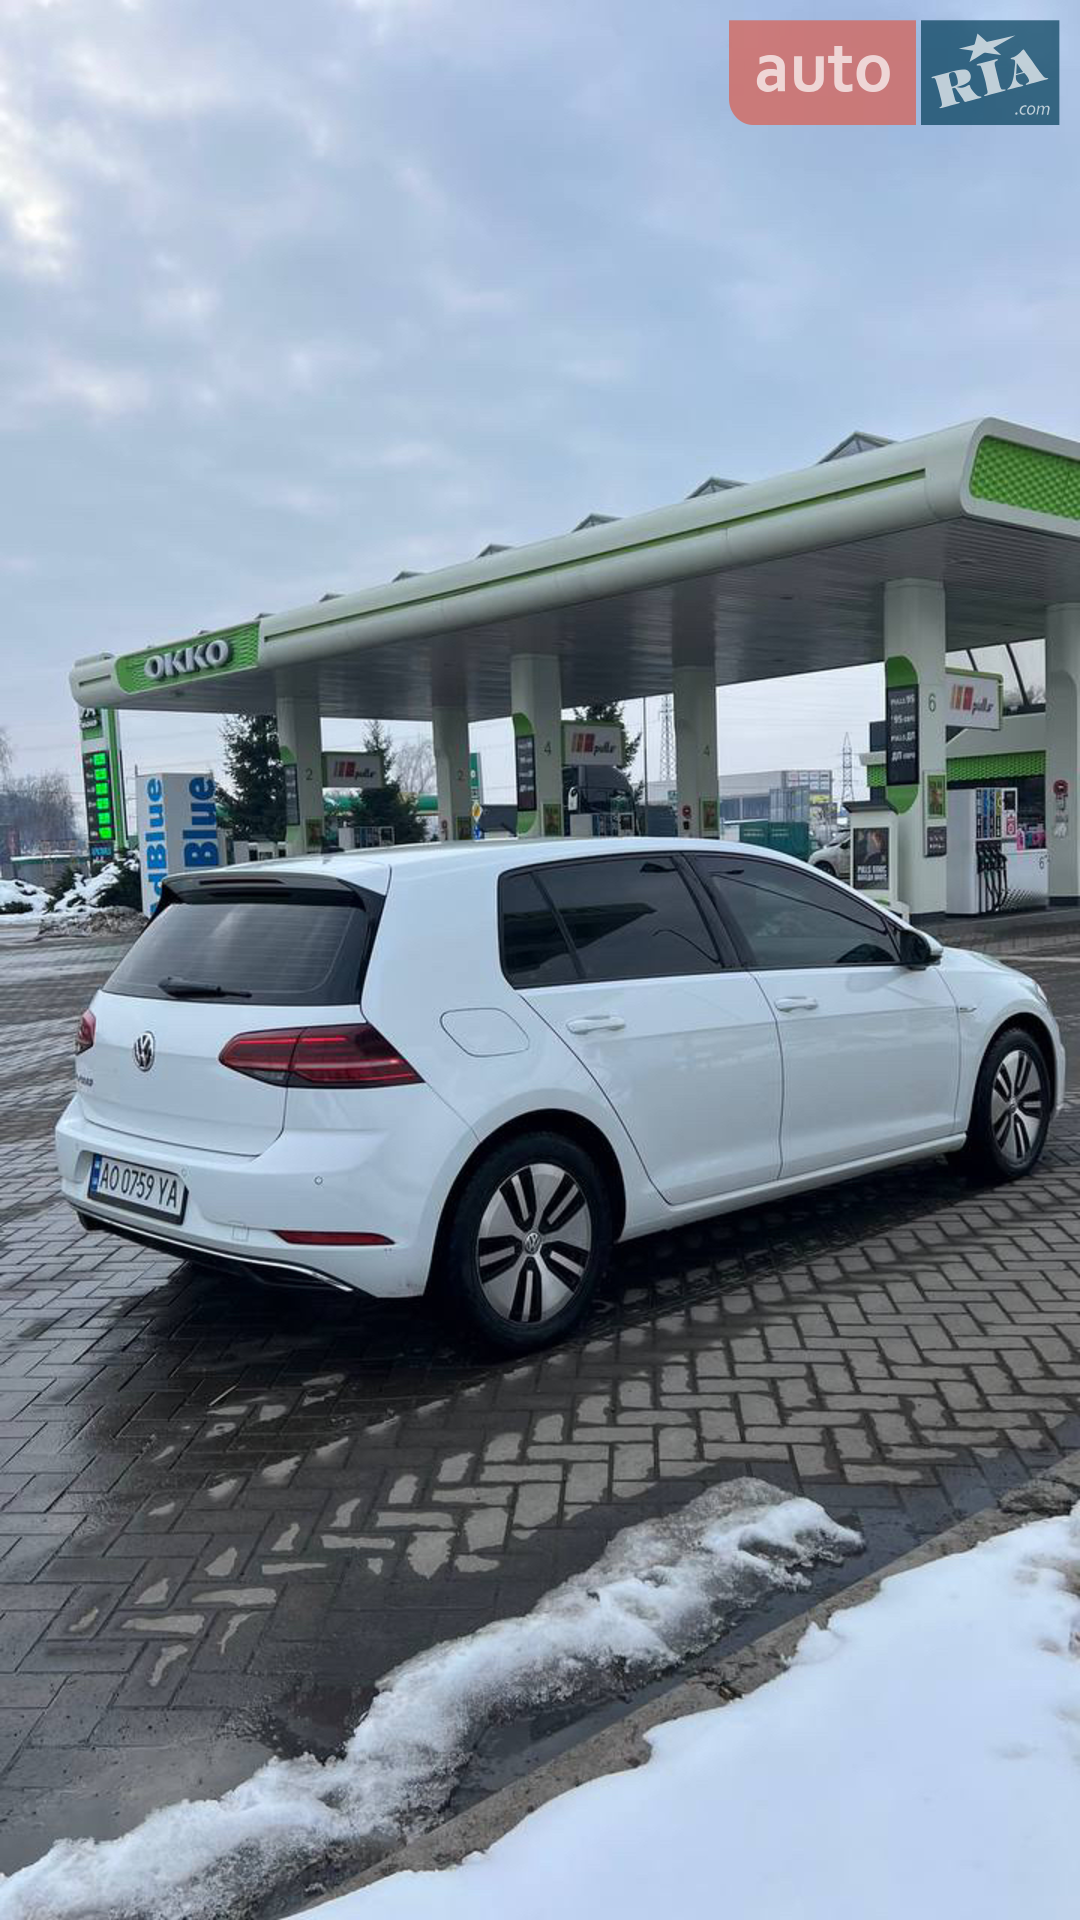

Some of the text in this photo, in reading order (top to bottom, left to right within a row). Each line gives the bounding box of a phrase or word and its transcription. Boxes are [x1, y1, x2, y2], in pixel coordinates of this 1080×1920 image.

[144, 640, 229, 678] OKKO
[928, 693, 937, 713] 6
[305, 768, 313, 781] 2
[182, 776, 219, 867] Blue
[100, 1162, 178, 1208] AO 0759 YA
